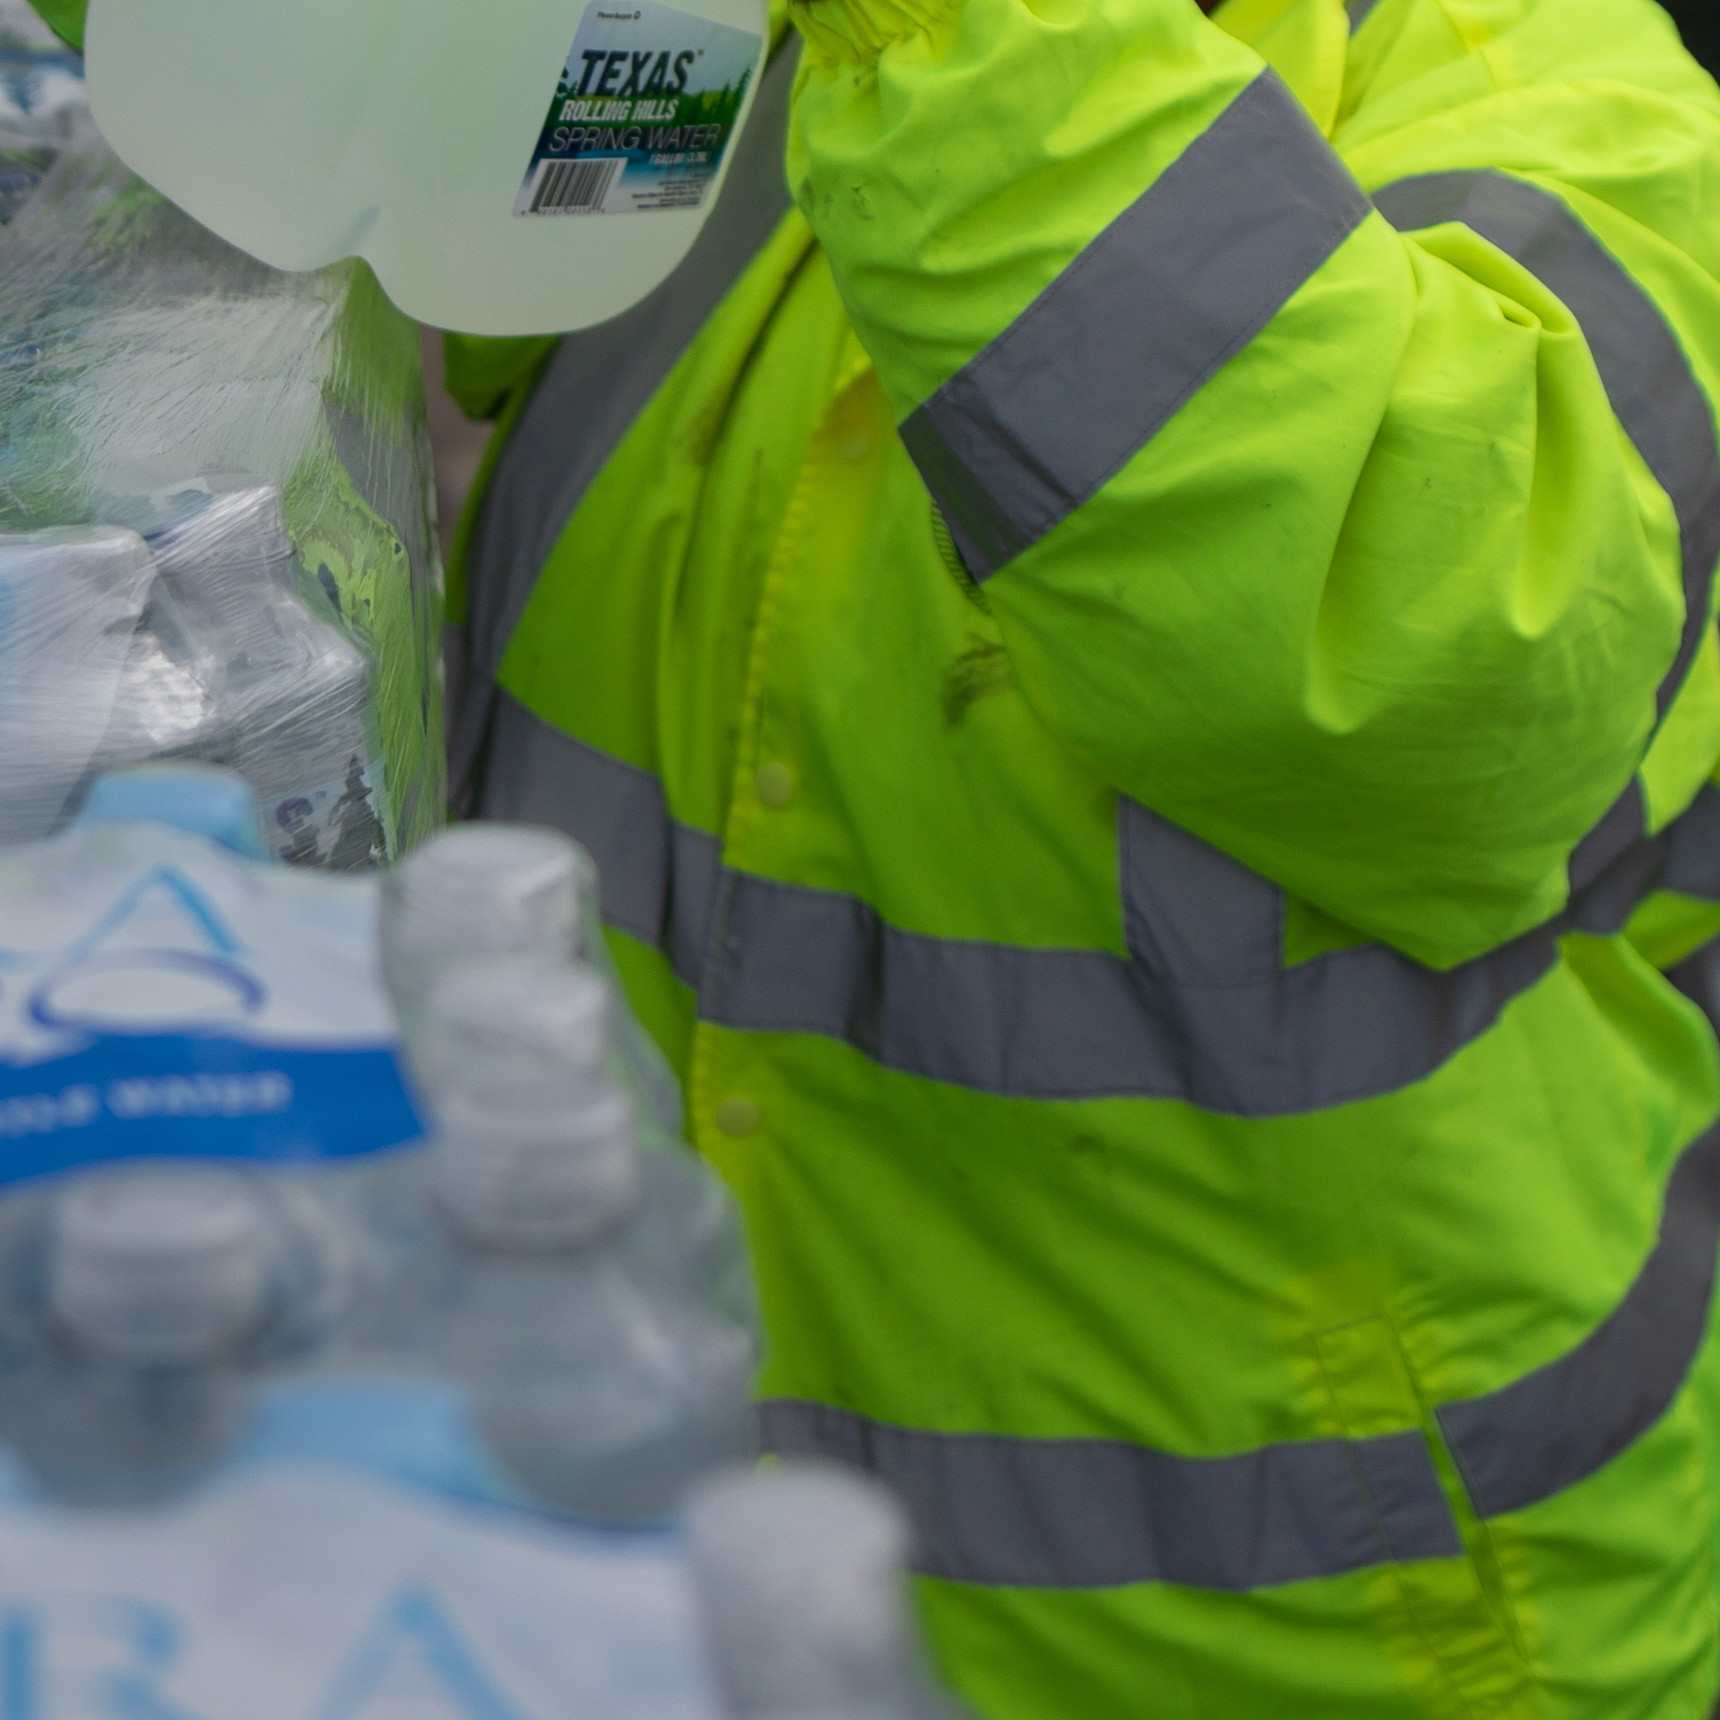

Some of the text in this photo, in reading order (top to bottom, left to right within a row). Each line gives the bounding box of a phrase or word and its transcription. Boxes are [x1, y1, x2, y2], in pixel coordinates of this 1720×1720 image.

[576, 48, 695, 97] TEXAS
[559, 98, 679, 121] ROLLING HILLS
[549, 123, 722, 152] SPRING WATER
